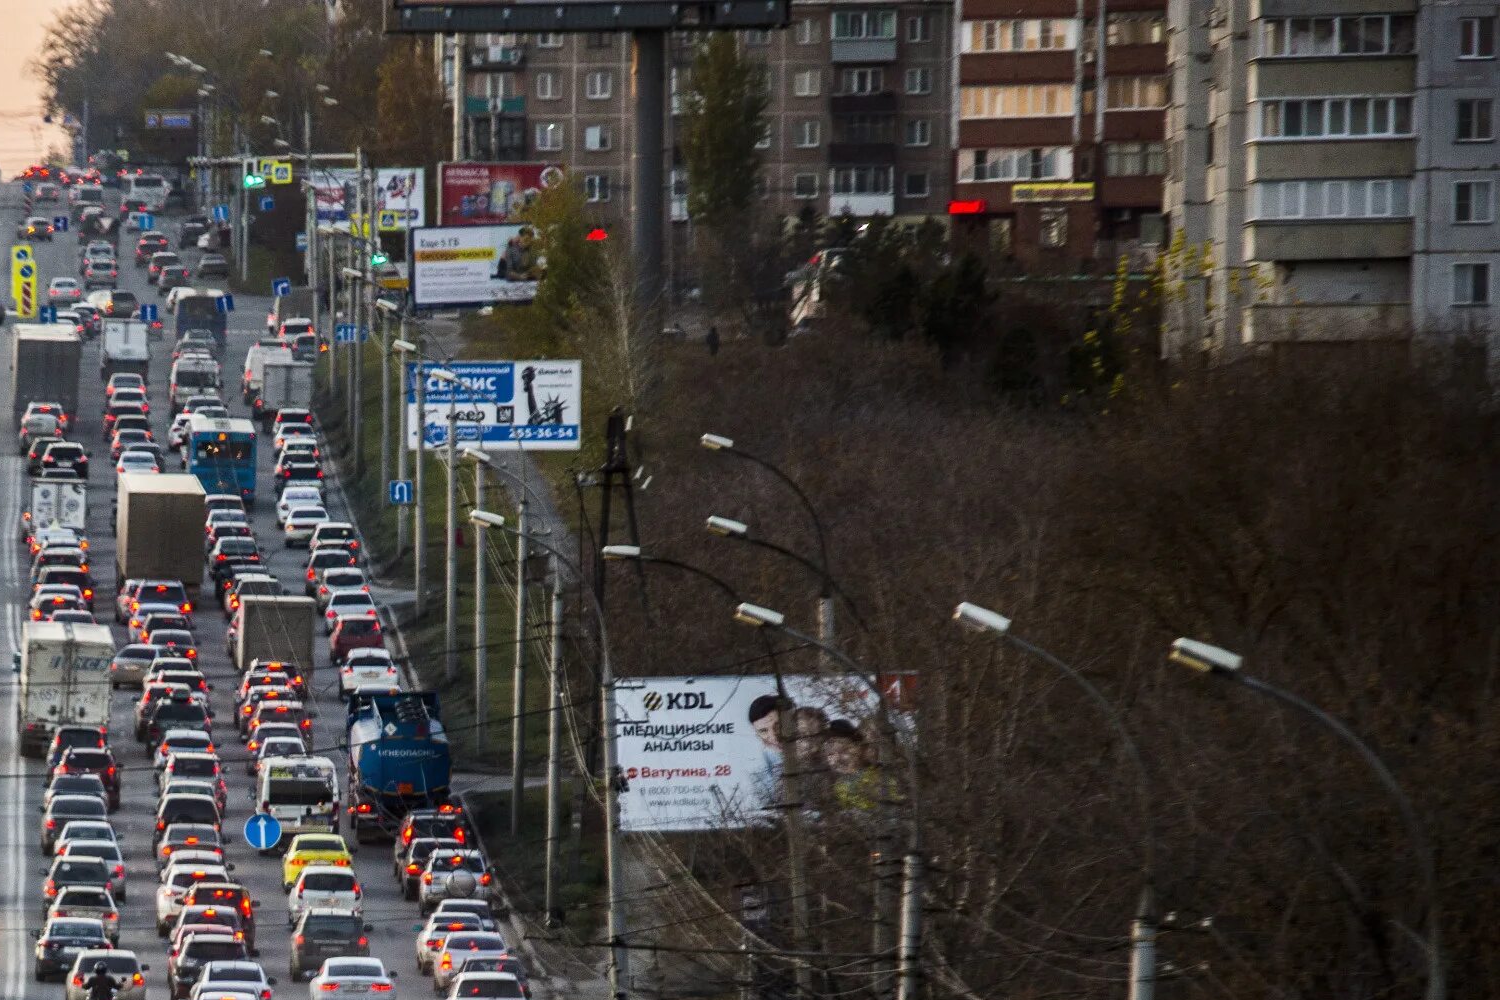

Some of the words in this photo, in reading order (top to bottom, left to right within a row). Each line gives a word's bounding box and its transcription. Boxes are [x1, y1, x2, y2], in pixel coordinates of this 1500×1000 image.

[666, 692, 714, 710] KDL
[622, 723, 735, 738] МЕДИЦИНСКИЕ
[643, 740, 714, 752] АНАЛИЗЫ
[641, 766, 711, 780] Ватутина,
[715, 765, 731, 777] 28
